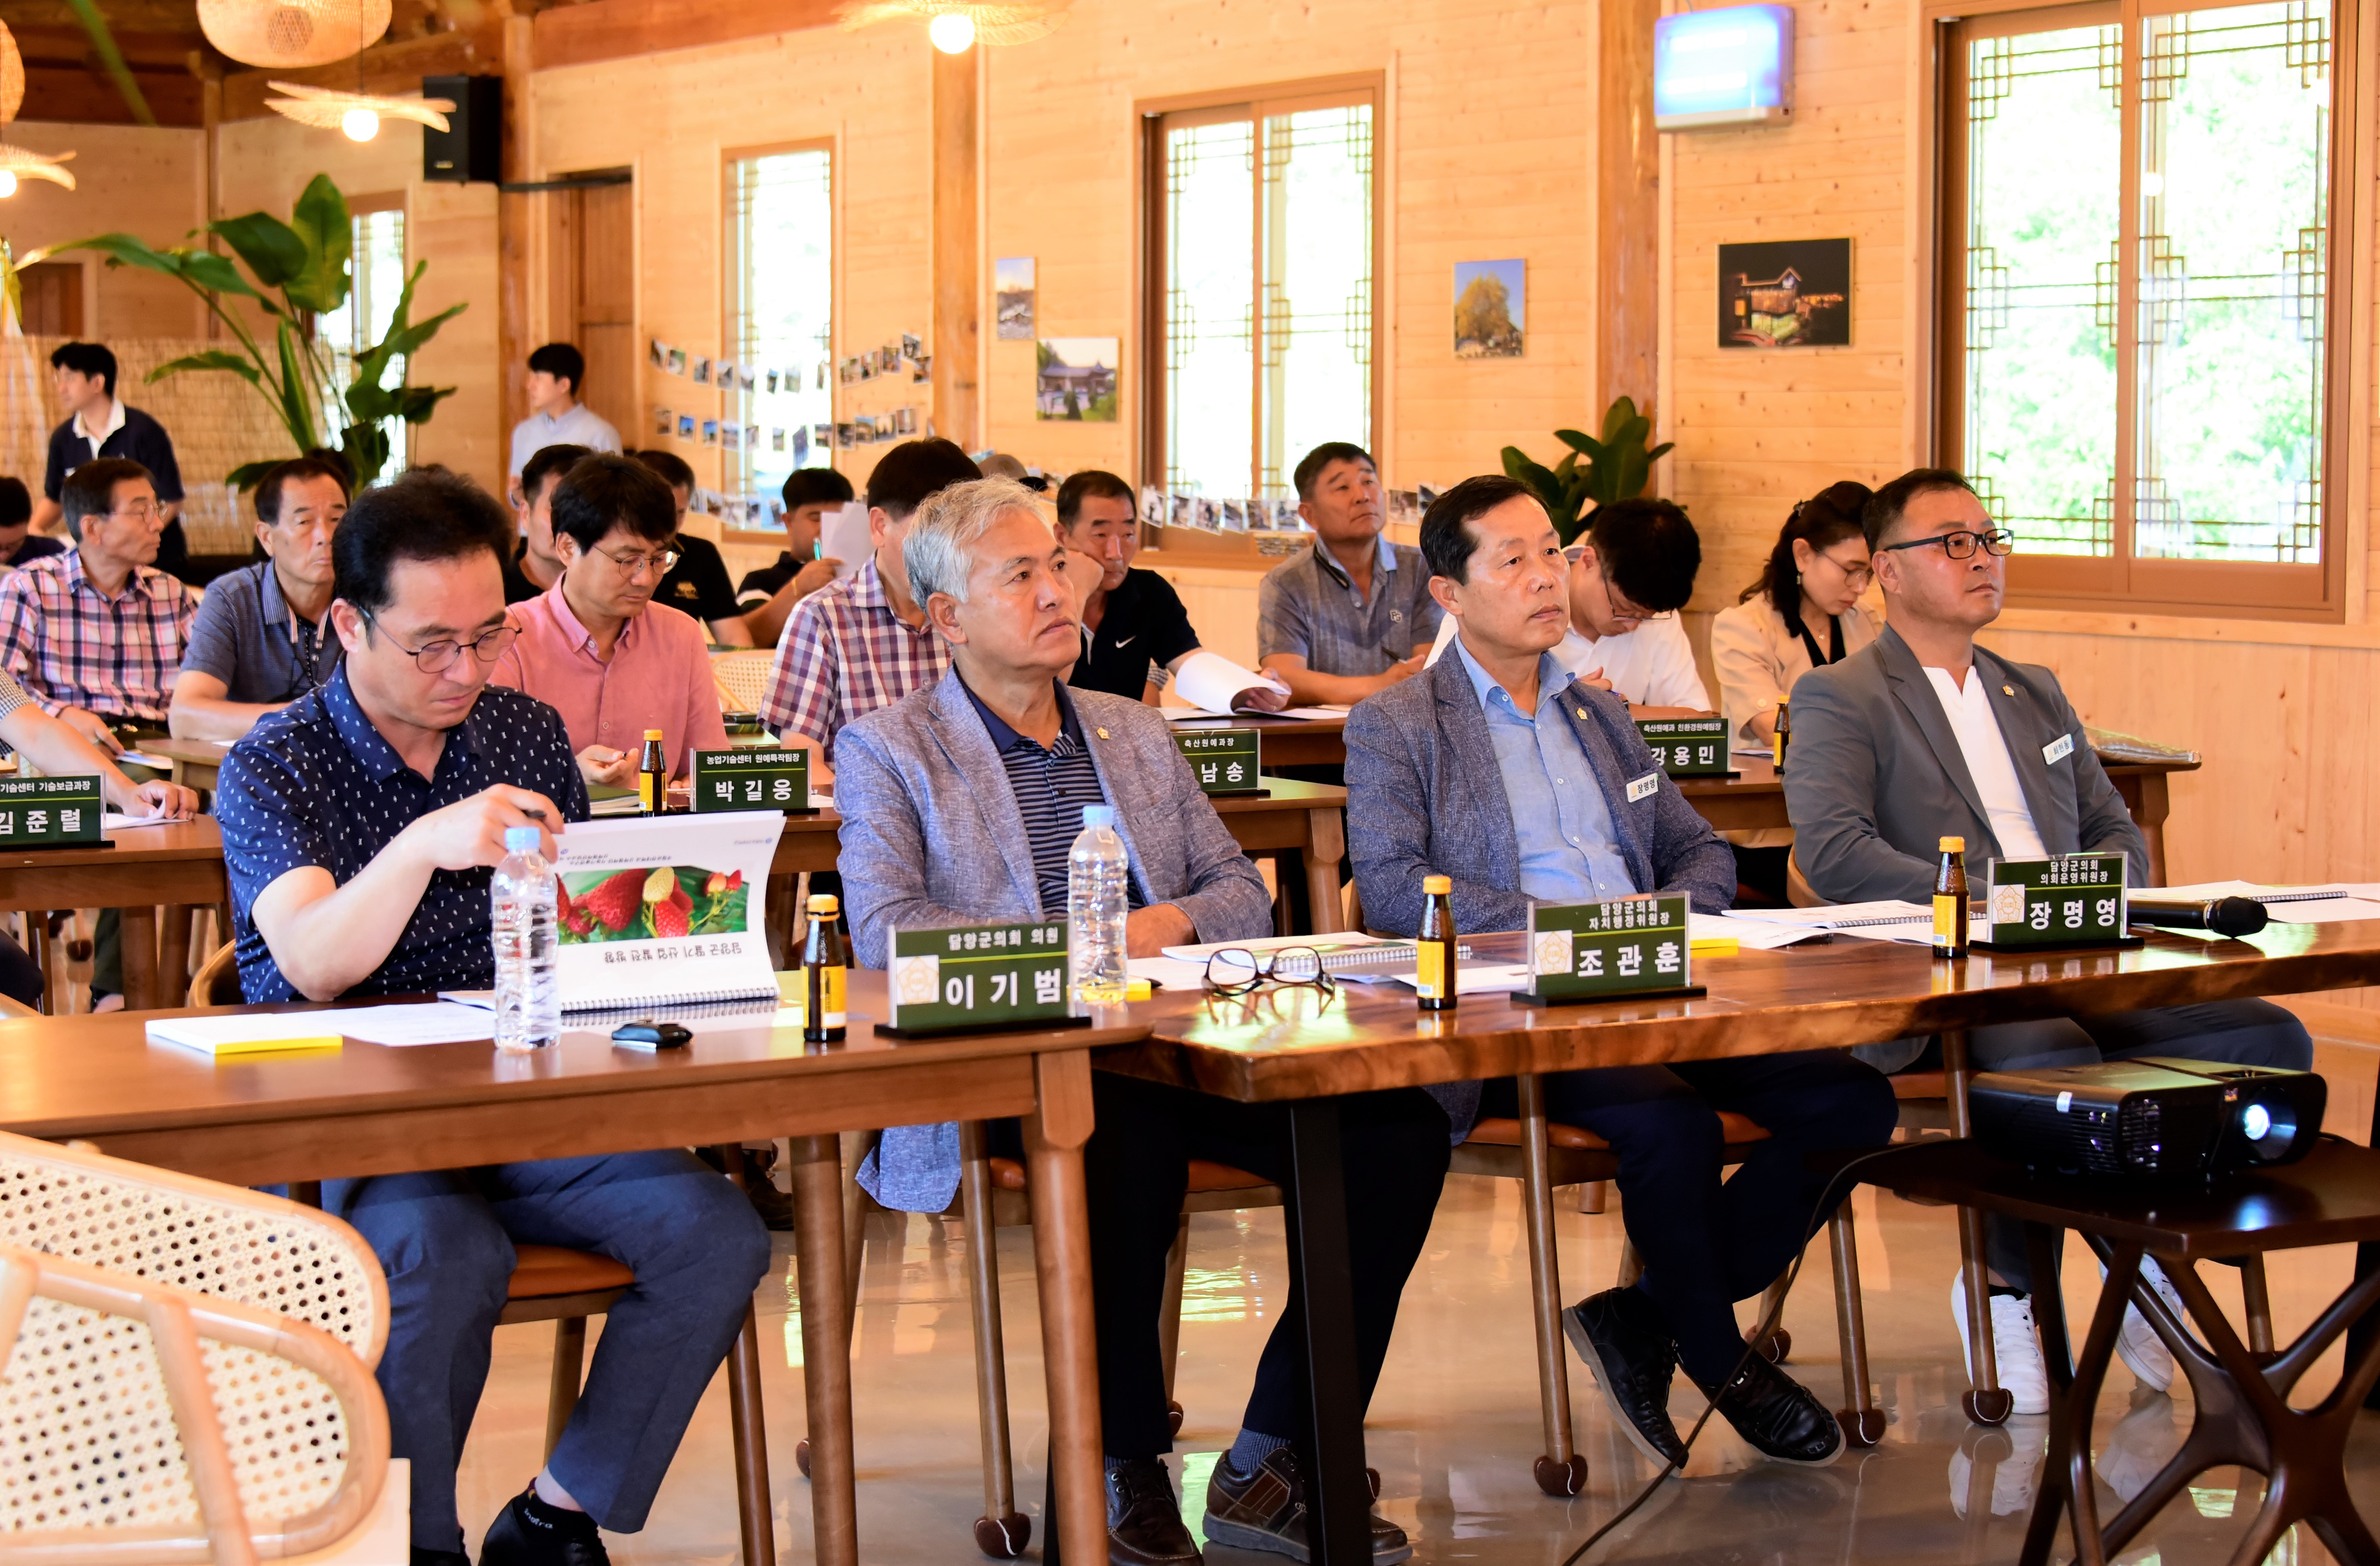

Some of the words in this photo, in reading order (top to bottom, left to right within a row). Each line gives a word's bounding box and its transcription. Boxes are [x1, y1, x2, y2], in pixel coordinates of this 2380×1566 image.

[707, 755, 752, 765] 농업기술센터
[755, 753, 800, 763] 원예특작팀장
[1189, 762, 1243, 783] 남송
[0, 782, 35, 793] 기술센터
[39, 780, 91, 792] 기술보급과장
[716, 779, 792, 802] 박길웅
[1638, 778, 1655, 793] 장명영
[2050, 860, 2098, 872] 담양군의회
[2040, 871, 2108, 885] 의회운영위원장
[1601, 899, 1658, 916] 담양군의회
[2030, 898, 2116, 930] 장명영
[1589, 912, 1670, 931] 자치행정위원장
[948, 929, 1021, 951] 담양군의회
[1578, 942, 1680, 977] 조관훈
[946, 968, 1061, 1010] 이기범
